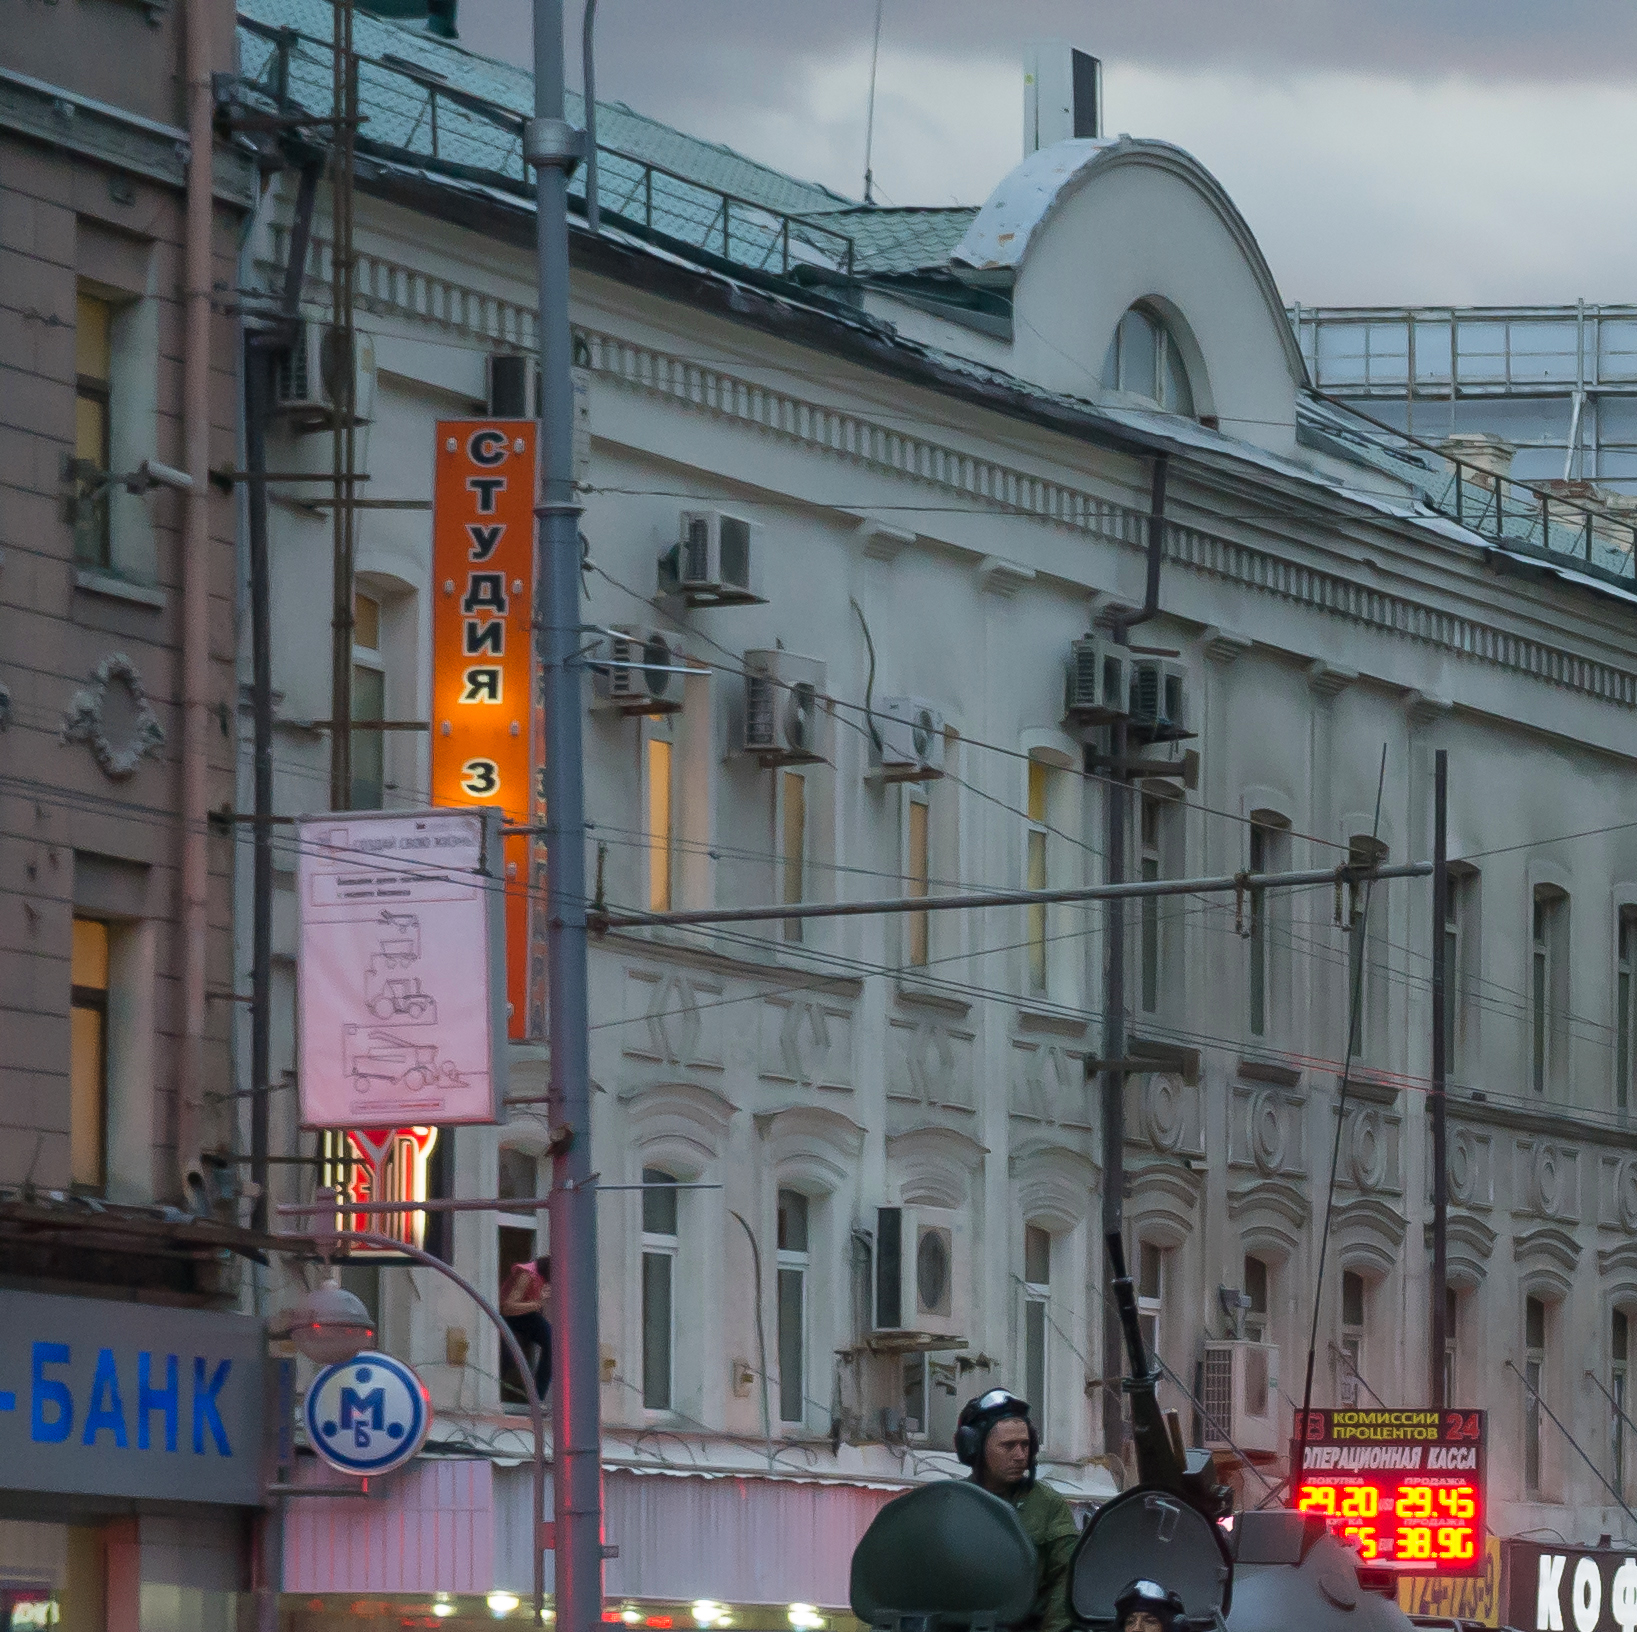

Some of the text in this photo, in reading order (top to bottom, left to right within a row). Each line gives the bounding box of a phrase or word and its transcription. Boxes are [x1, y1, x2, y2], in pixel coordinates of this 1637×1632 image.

[460, 429, 510, 704] СТУДИЯ
[1331, 1412, 1440, 1425] КОМИССИИ
[1445, 1413, 1480, 1440] 24
[1331, 1426, 1439, 1440] ПРОЦЕНТОВ
[1303, 1446, 1477, 1472] ОПЕРАЦИОННАЯ КАССА
[1299, 1486, 1379, 1516] 29.20
[1395, 1486, 1475, 1518] 29.45
